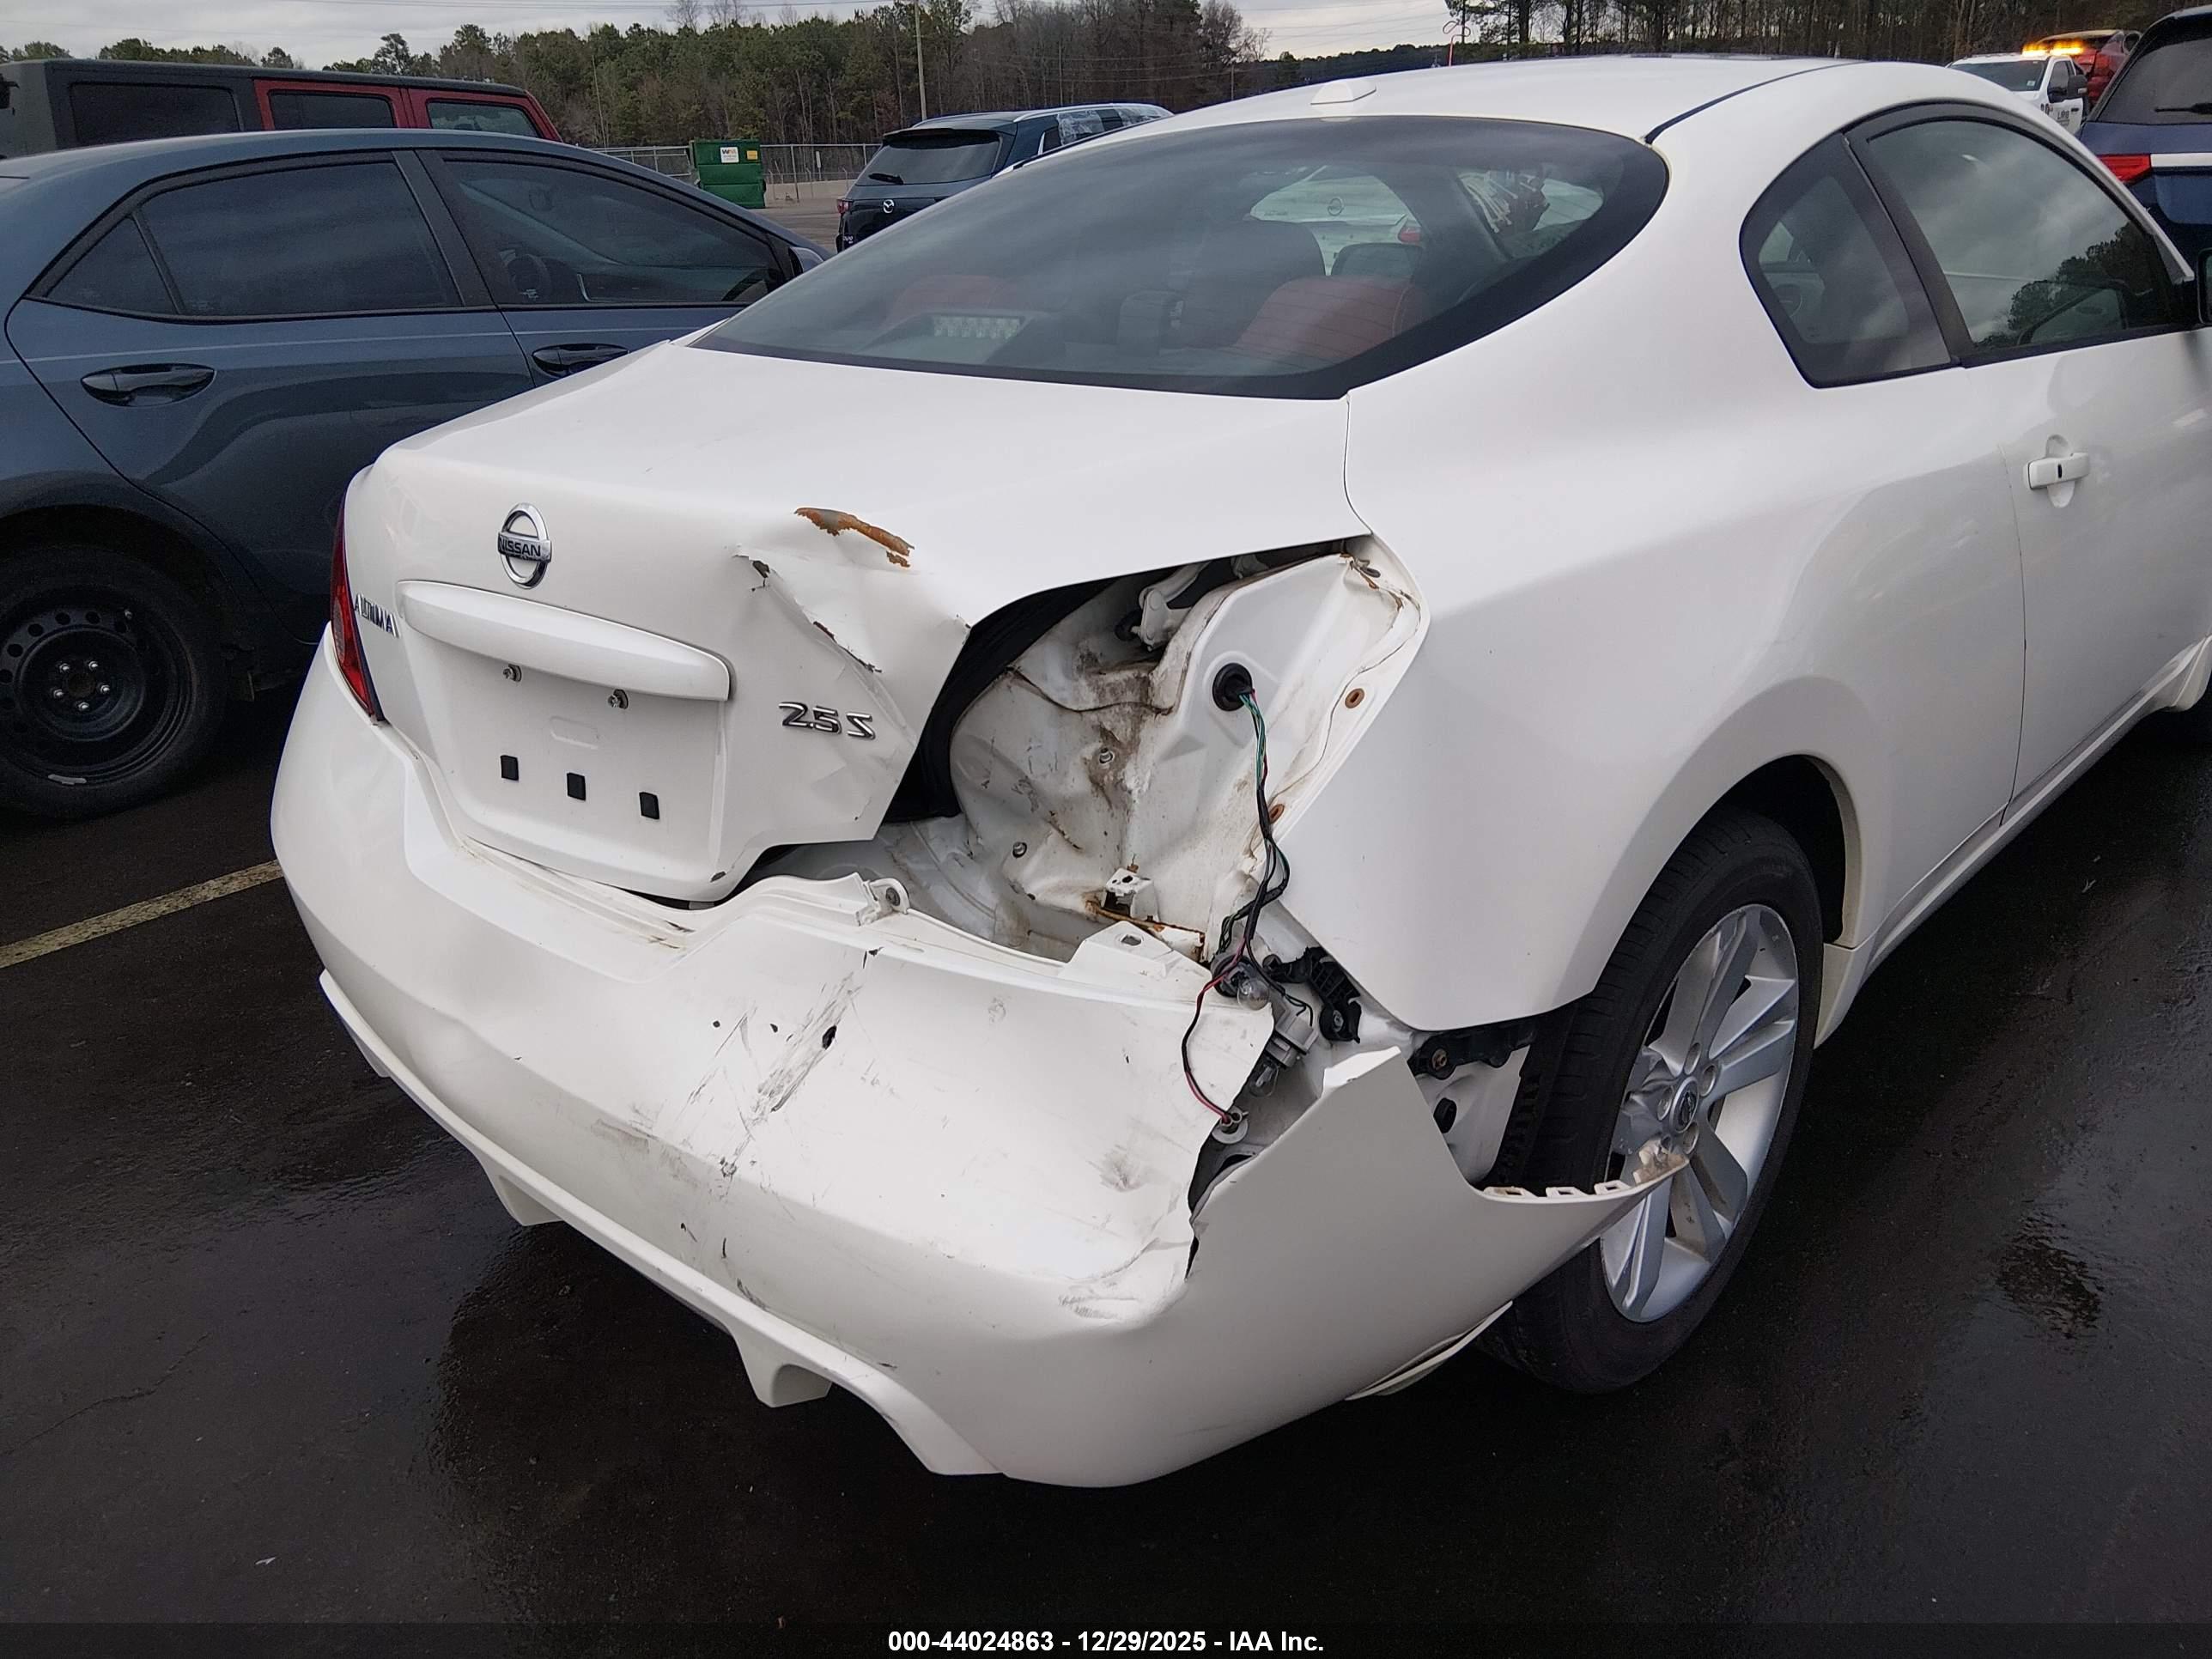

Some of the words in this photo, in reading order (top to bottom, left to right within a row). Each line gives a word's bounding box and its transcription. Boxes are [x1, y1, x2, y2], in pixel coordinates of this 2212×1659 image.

[497, 535, 542, 558] NISSAN
[778, 702, 842, 735] 2.5
[846, 712, 876, 740] S
